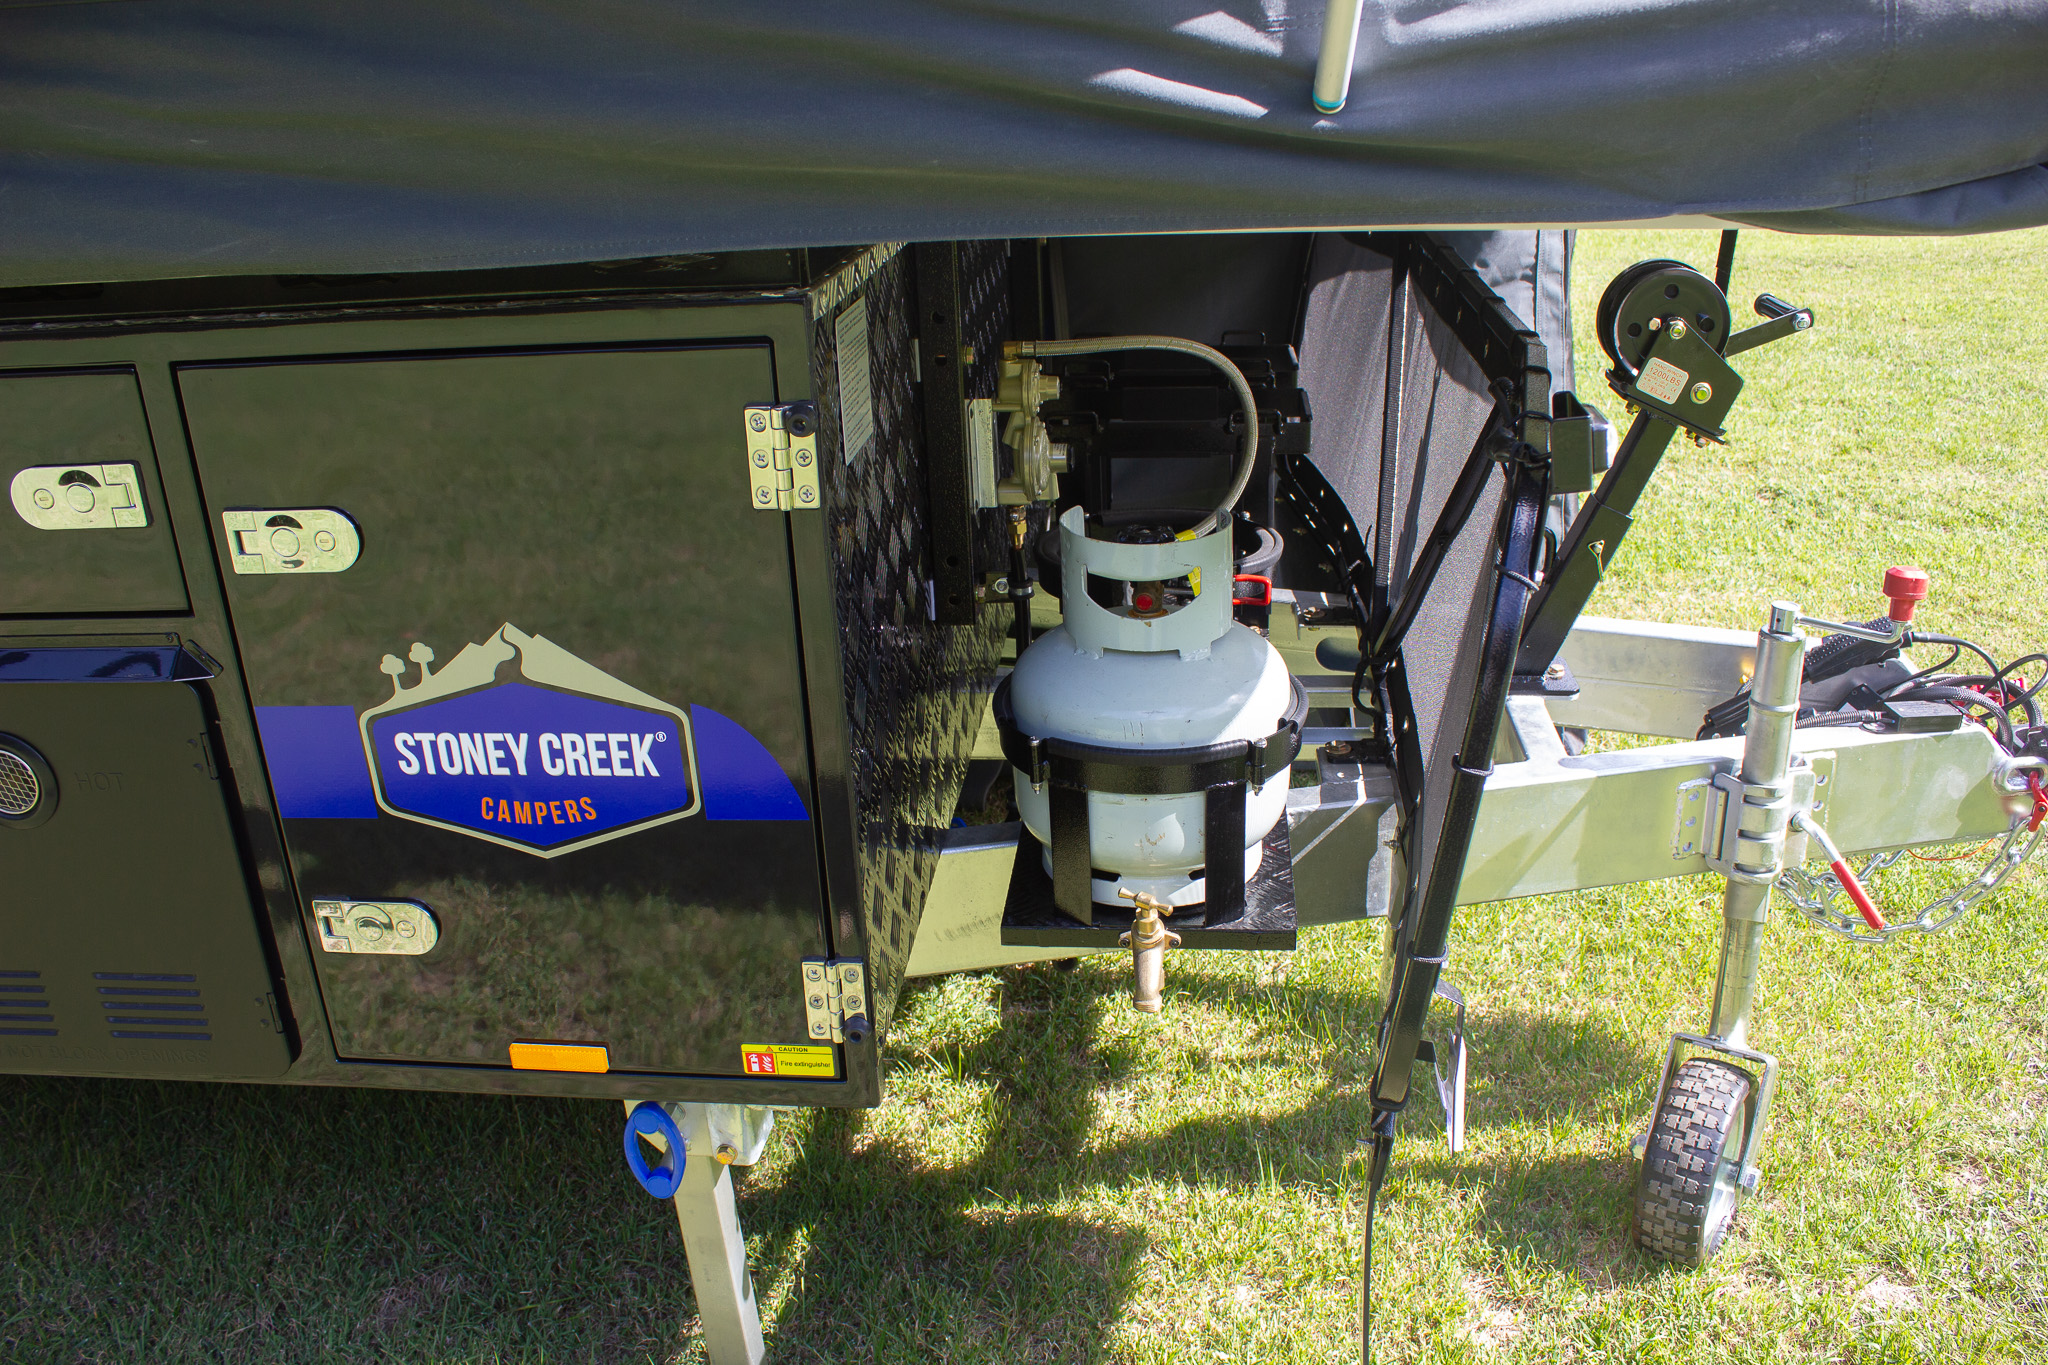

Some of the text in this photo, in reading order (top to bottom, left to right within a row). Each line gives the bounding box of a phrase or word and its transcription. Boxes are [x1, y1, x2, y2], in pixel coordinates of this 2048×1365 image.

[1650, 367, 1681, 386] 1200LBS
[394, 732, 529, 776] STONEY
[73, 771, 124, 793] HOT
[481, 797, 597, 825] CAMPERS
